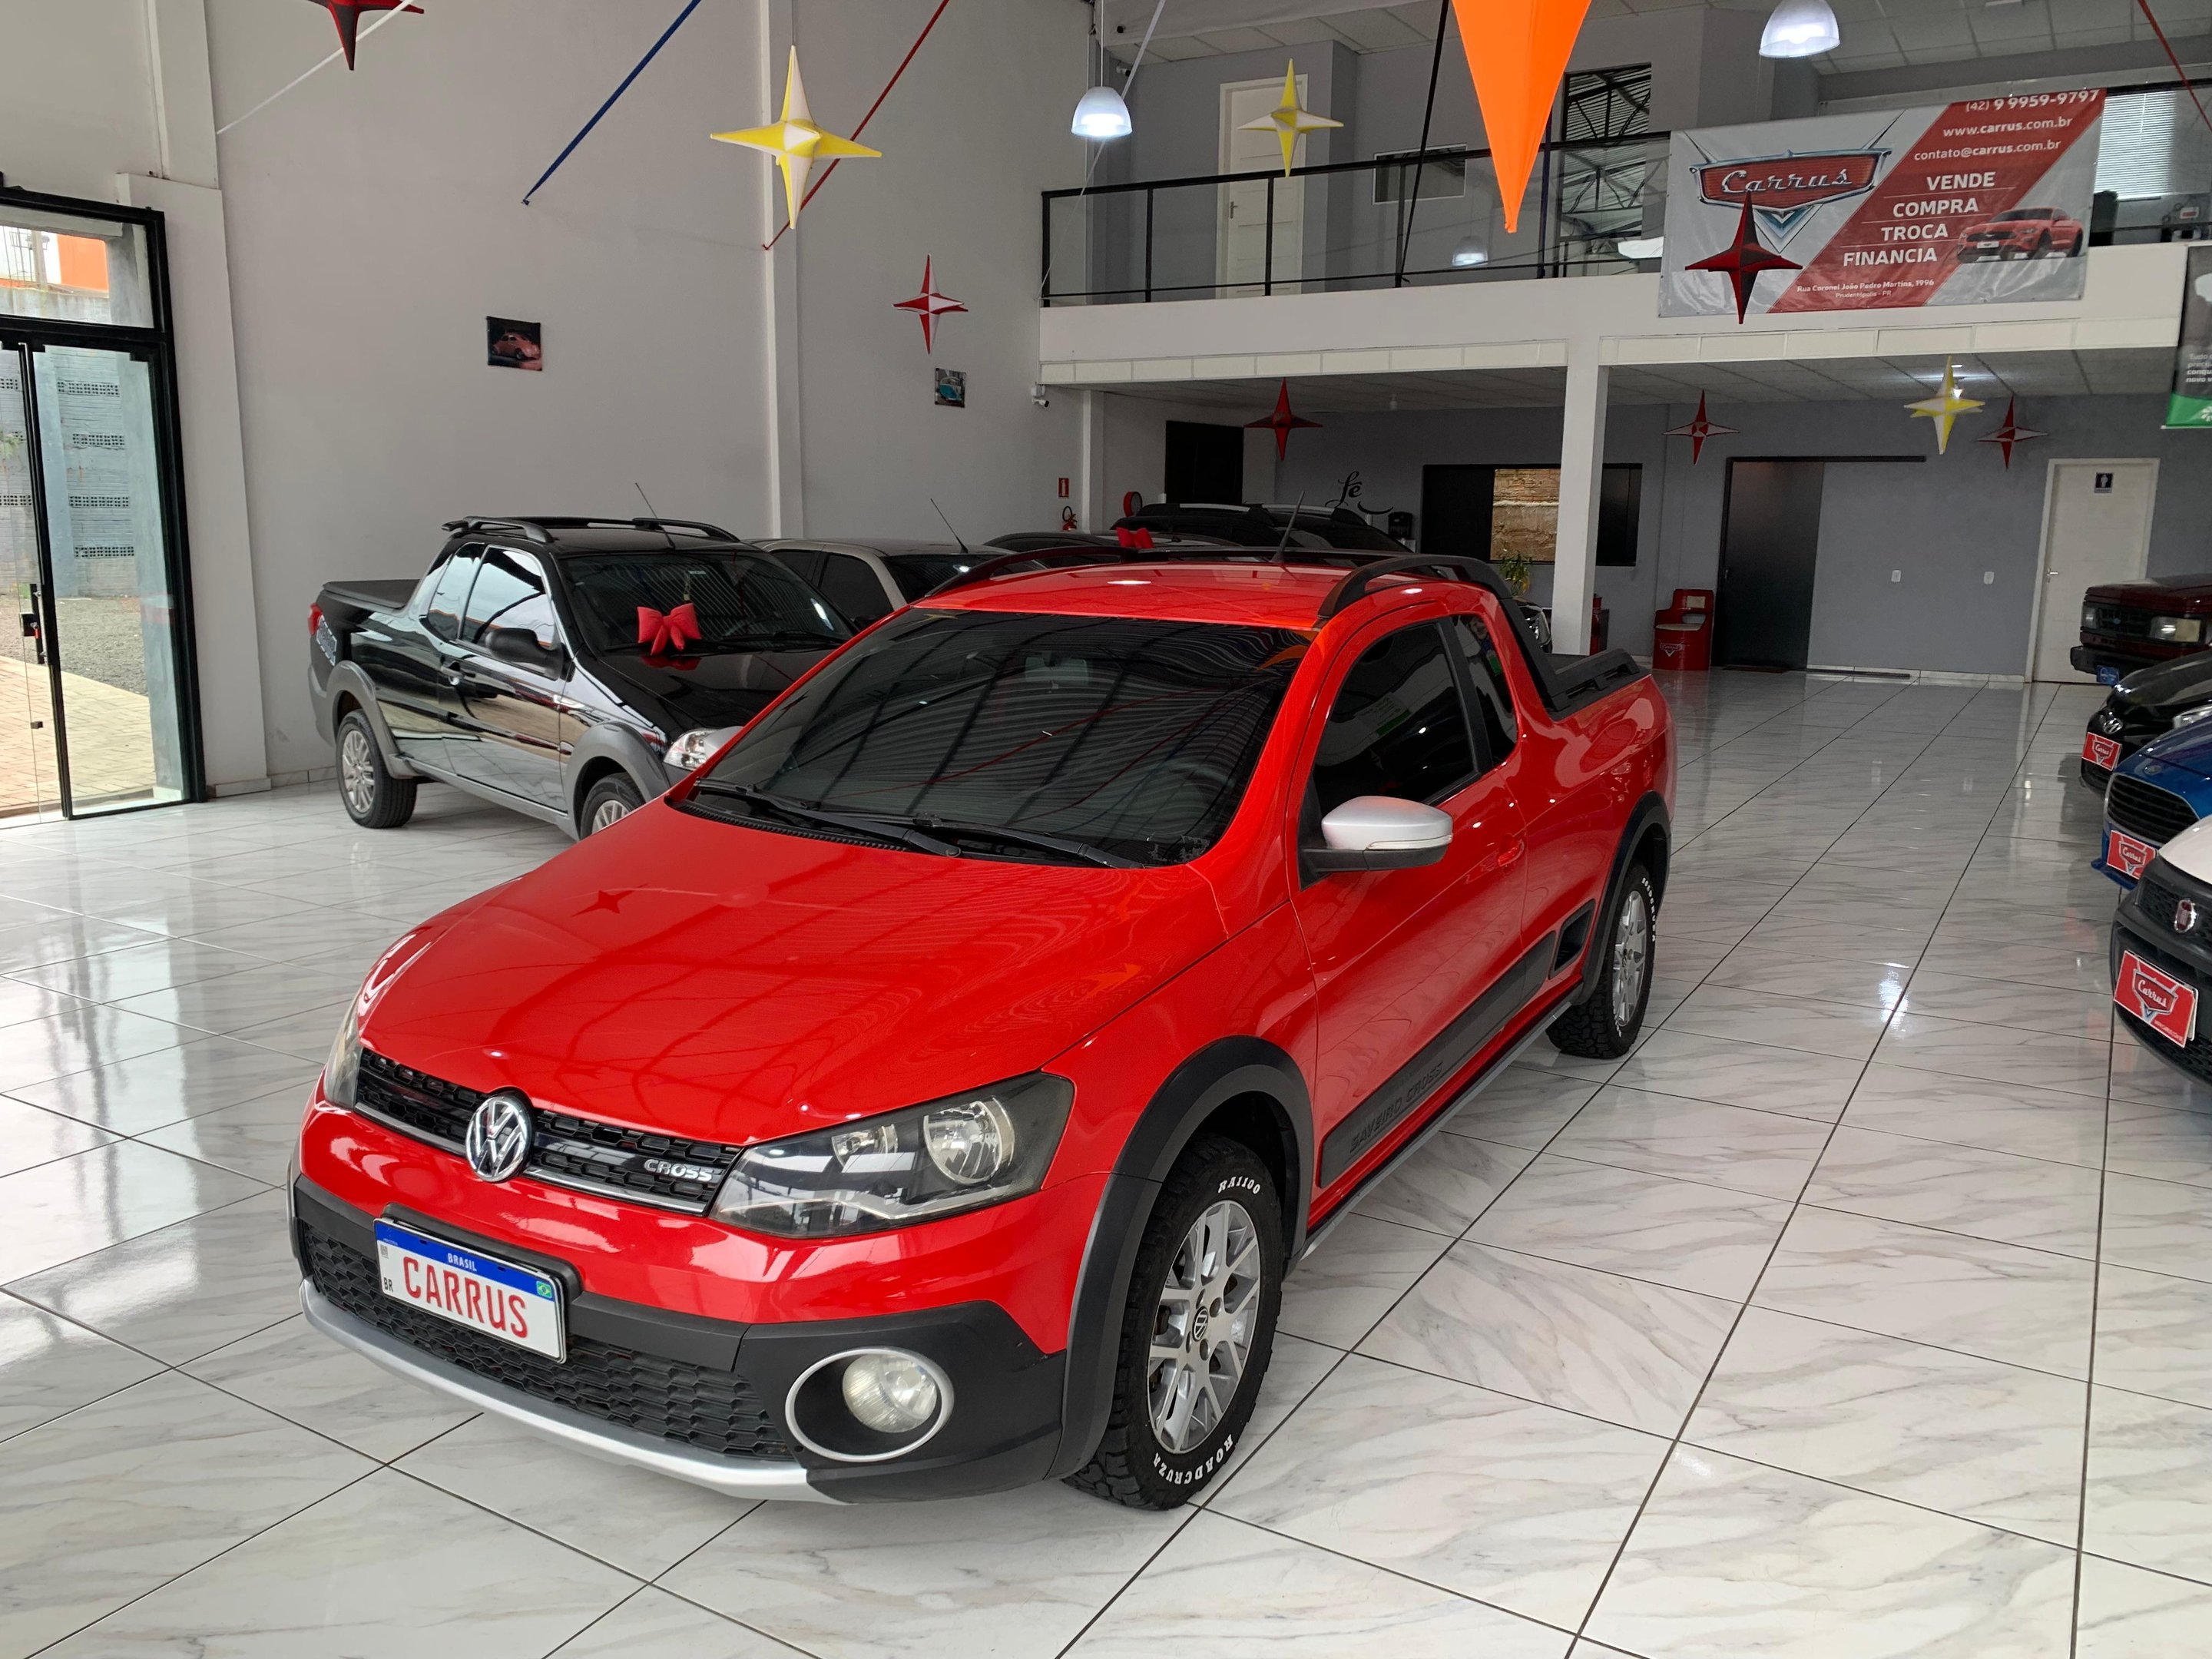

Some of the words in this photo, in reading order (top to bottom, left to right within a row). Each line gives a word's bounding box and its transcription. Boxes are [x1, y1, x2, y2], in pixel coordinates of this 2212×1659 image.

[1965, 101, 1989, 113] (42)
[1994, 99, 2004, 111] 9
[2008, 89, 2100, 109] 9959-9797
[1942, 117, 2073, 137] www.carrus.com.br
[1914, 140, 2061, 161] contato@carrus.com.br
[1721, 168, 1853, 194] Carrus
[1926, 171, 1996, 190] VENDE
[1892, 197, 1979, 217] COMPRA
[1880, 223, 1949, 241] TROCA
[1843, 247, 1938, 267] FINANCIA
[1883, 280, 1914, 288] Martins,
[2137, 979, 2167, 1008] Carrus
[644, 1158, 714, 1181] CROSS
[1217, 1176, 1261, 1194] RA1100
[447, 1253, 478, 1272] BRASIL
[383, 1277, 394, 1293] BR
[402, 1256, 528, 1339] CARRUS
[1153, 1433, 1233, 1485] ROADCRUZA
